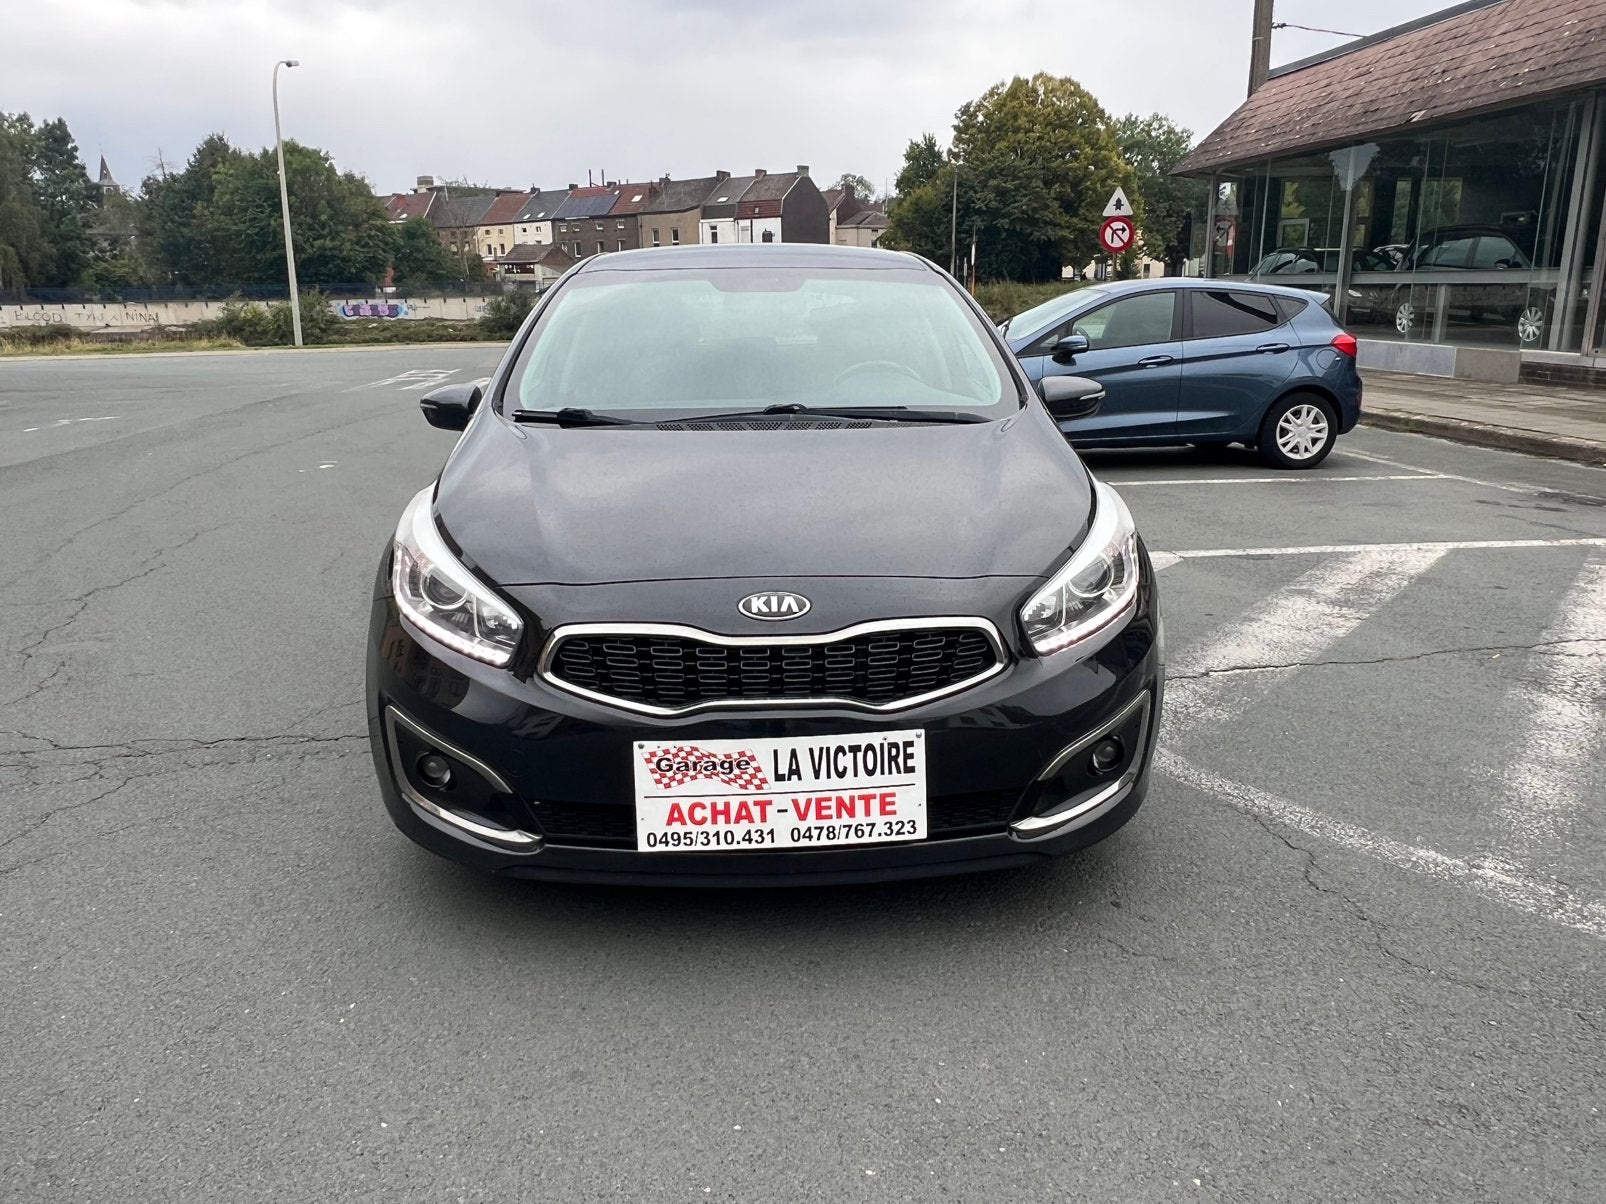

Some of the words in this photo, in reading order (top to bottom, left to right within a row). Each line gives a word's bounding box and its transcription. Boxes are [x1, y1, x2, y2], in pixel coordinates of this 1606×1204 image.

[750, 595, 800, 613] KIA
[655, 757, 751, 775] Garage
[773, 748, 802, 782] LA
[809, 740, 916, 780] VICTOIRE
[646, 828, 776, 848] 0495/310.431
[790, 819, 917, 843] 0478/767.323
